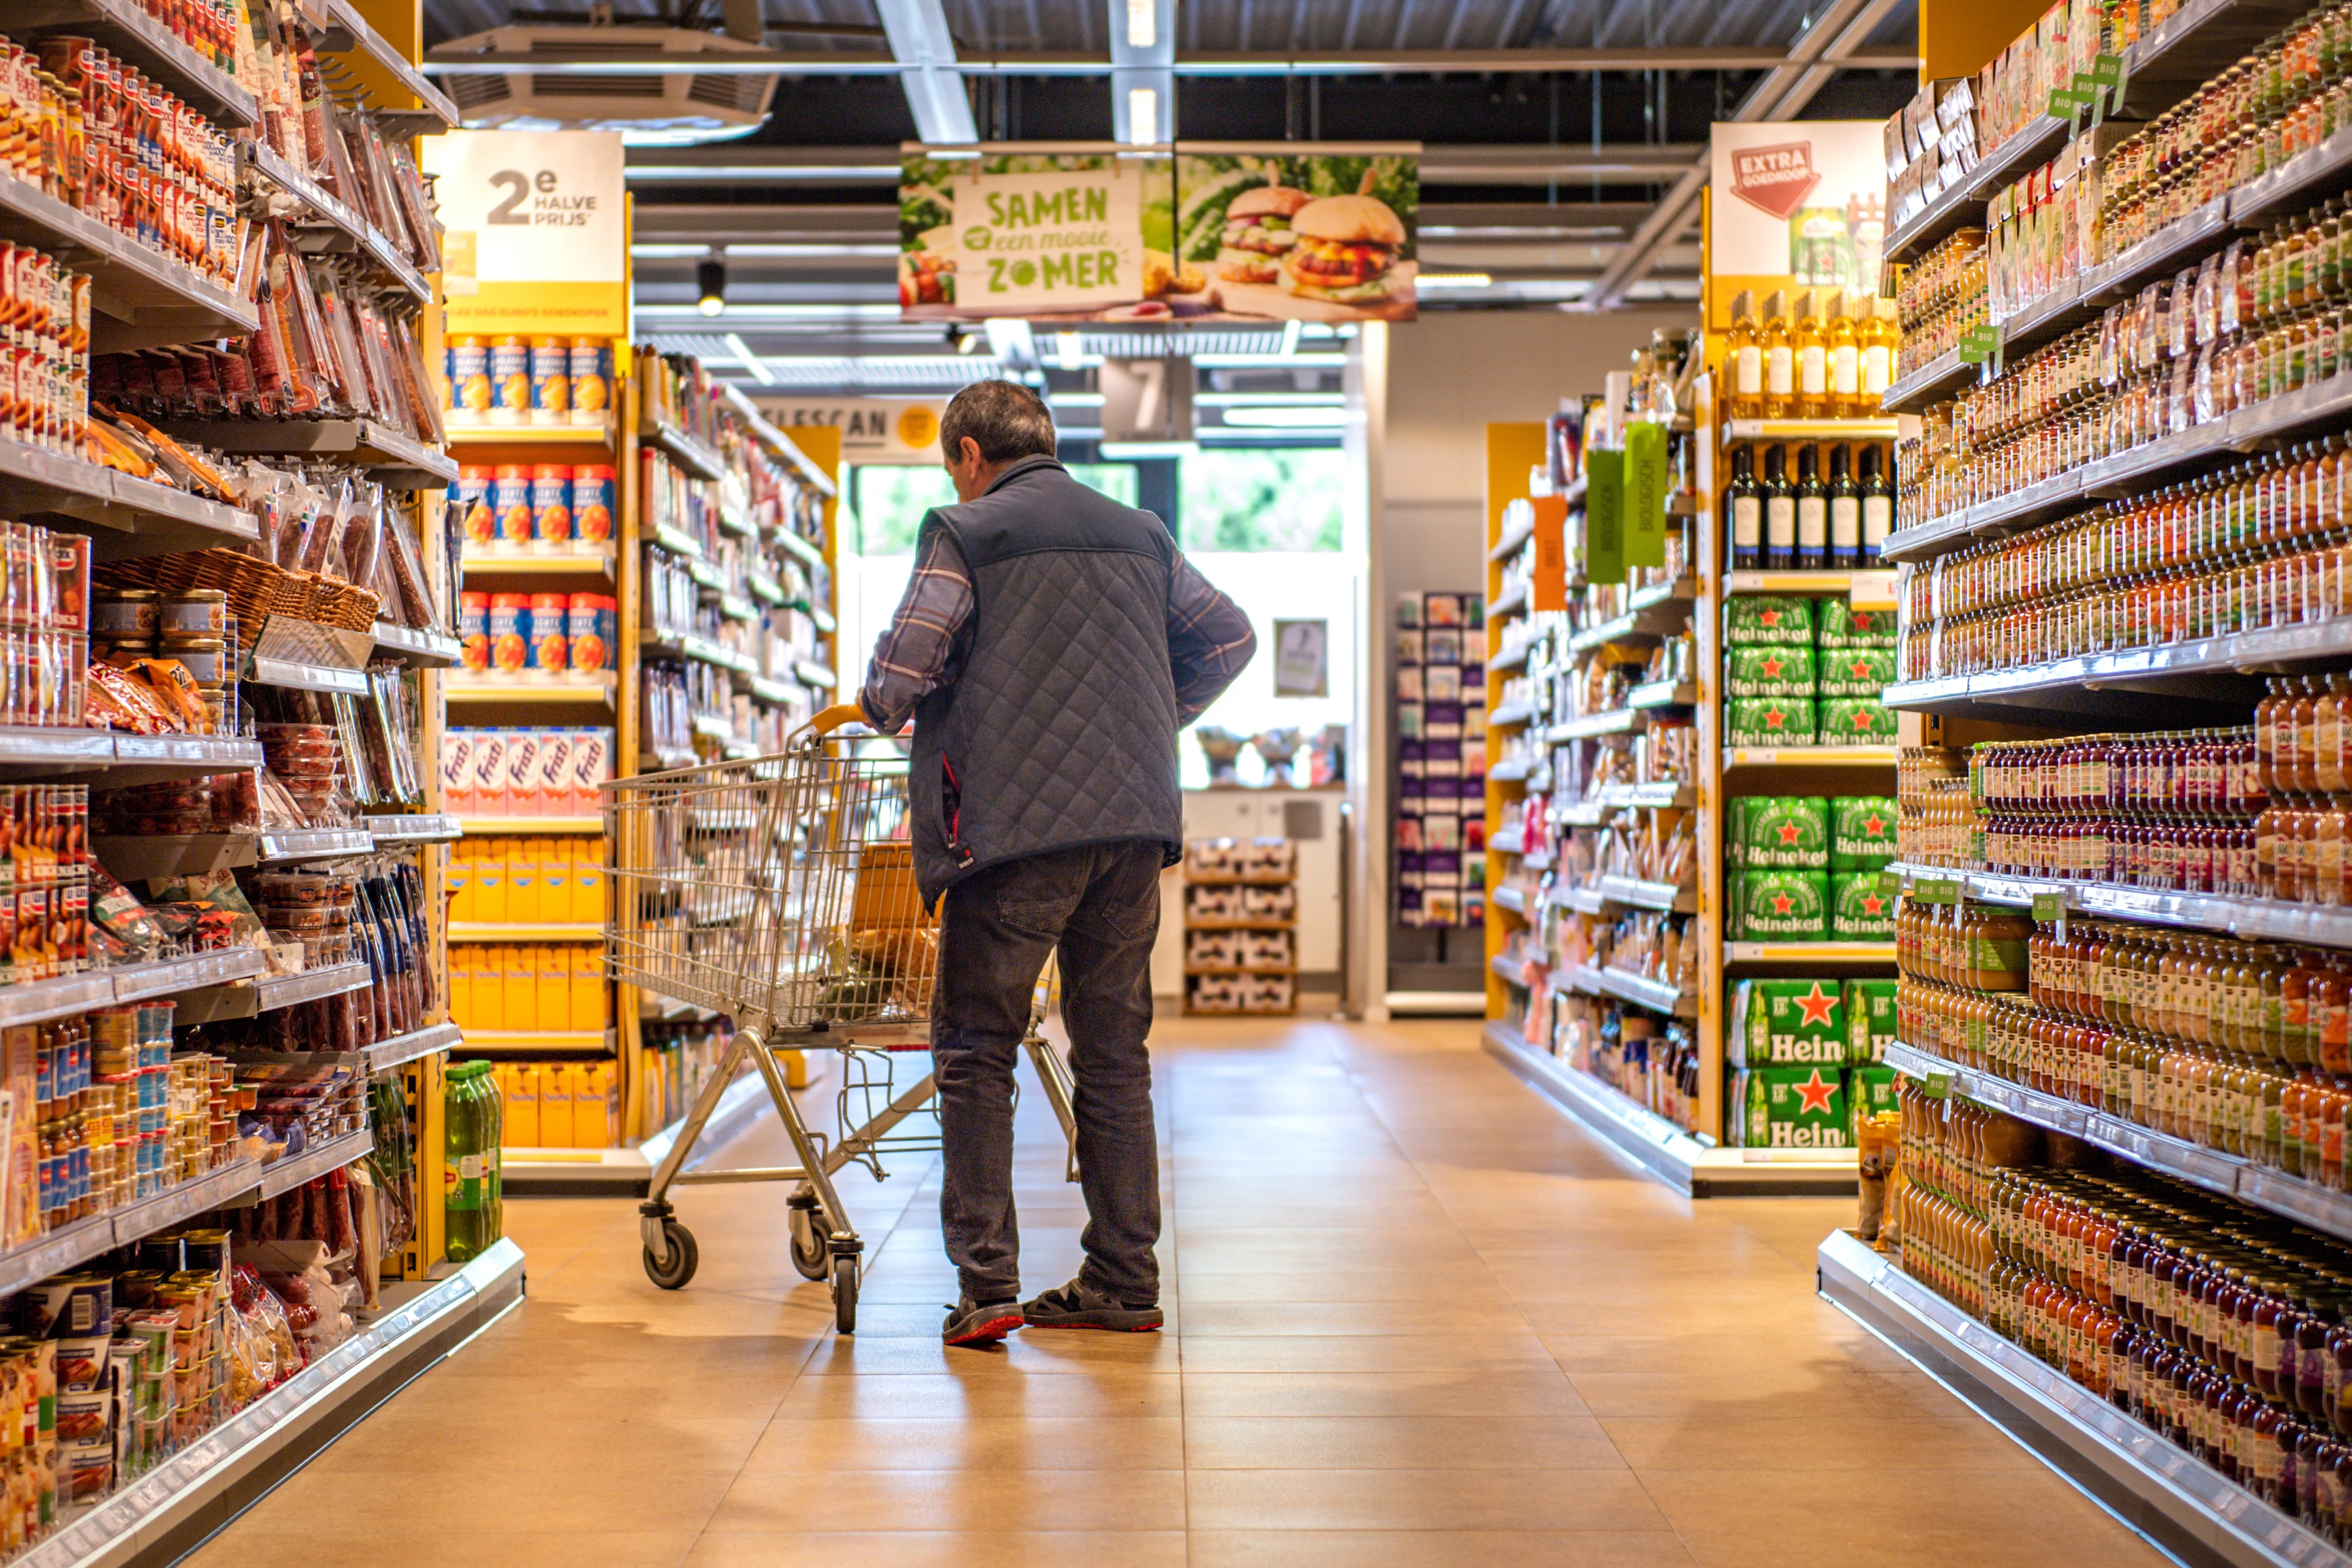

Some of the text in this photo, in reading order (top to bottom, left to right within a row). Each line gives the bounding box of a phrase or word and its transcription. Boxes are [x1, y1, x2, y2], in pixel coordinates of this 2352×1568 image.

[2100, 63, 2116, 75] BIO
[2078, 81, 2094, 92] BIO
[2054, 97, 2070, 108] BIO
[1740, 149, 1806, 173] EXTRA
[1742, 167, 1809, 188] GOEDKOOP
[535, 196, 597, 209] HALVE
[986, 187, 1107, 229] SAMEN
[995, 223, 1111, 251] een mooie
[987, 250, 1119, 292] ZOMER
[1978, 333, 1992, 341] BIO
[1131, 361, 1163, 430] 7
[1730, 626, 1811, 642] Heineken
[1731, 678, 1815, 696] Heineken
[1820, 679, 1893, 696] Heinek
[1732, 729, 1815, 746] Heineken
[445, 736, 470, 785] Fristi
[477, 736, 503, 785] Fristi
[510, 736, 537, 785] Fristi
[543, 736, 569, 785] Fristi
[576, 736, 602, 785] Fristi
[1837, 835, 1896, 855] Heinek
[1748, 845, 1828, 865] Heineken
[1882, 877, 1895, 886] BIO
[1920, 885, 1932, 895] BIO
[1939, 886, 1953, 895] BIO
[2038, 900, 2052, 910] BIO
[1746, 913, 1823, 932] Heineken
[1834, 914, 1895, 933] Heinek
[1771, 1035, 1845, 1061] Hein
[1930, 1080, 1943, 1089] BIO
[1770, 1121, 1845, 1148] Hein
